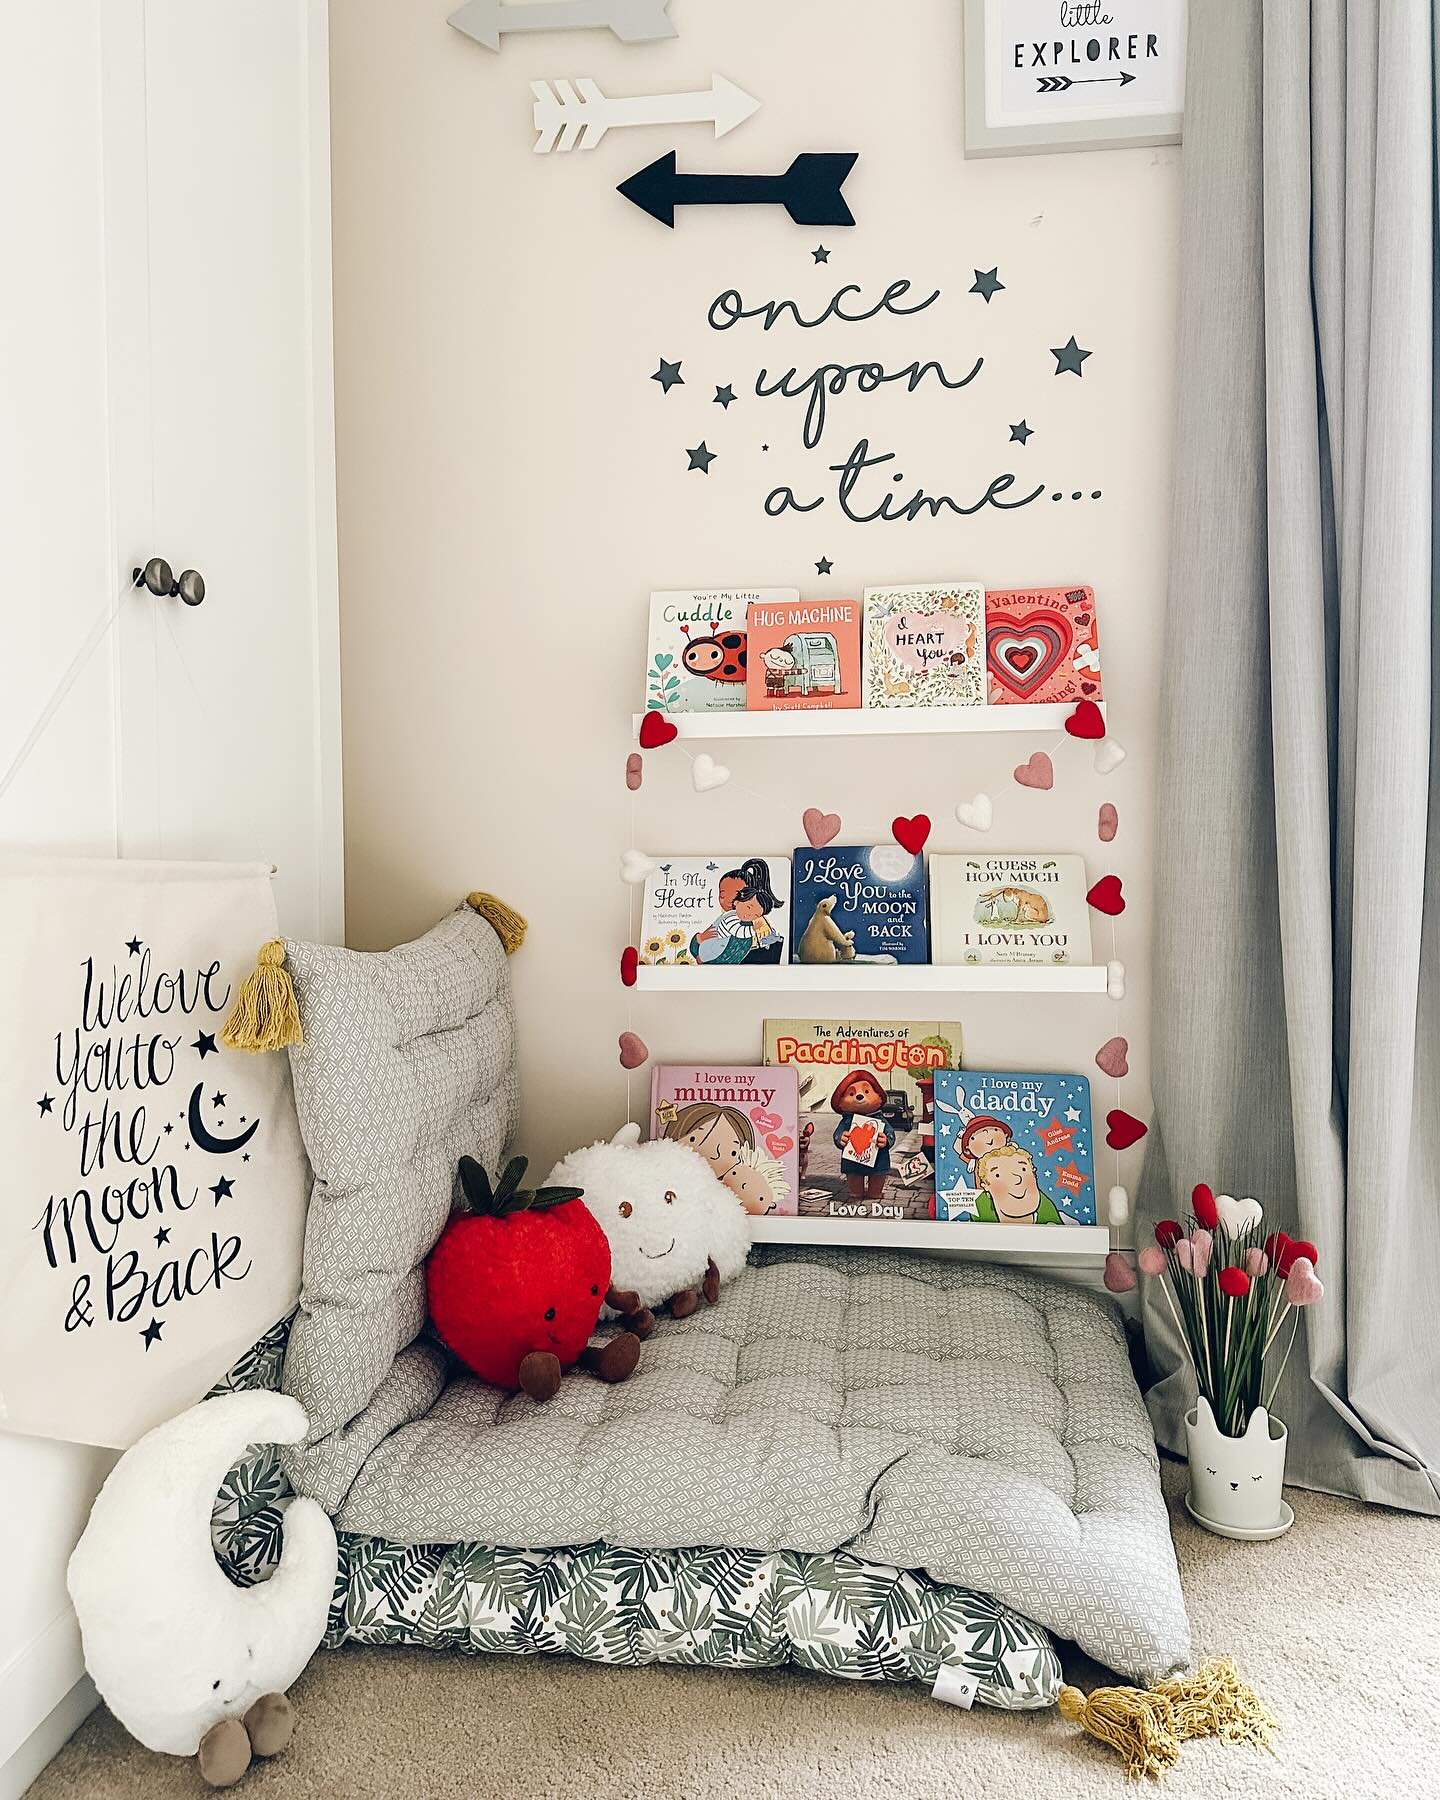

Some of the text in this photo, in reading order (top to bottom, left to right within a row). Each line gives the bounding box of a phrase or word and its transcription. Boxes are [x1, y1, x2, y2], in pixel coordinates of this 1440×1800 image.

[1060, 0, 1114, 28] little
[1014, 33, 1159, 68] EXPLORER
[708, 279, 940, 331] once
[755, 357, 984, 449] upon
[764, 487, 825, 517] a
[721, 592, 732, 601] My
[735, 592, 760, 600] Little
[990, 594, 1069, 613] Valentine
[663, 602, 733, 622] Cuddle
[754, 609, 785, 627] HUG
[788, 606, 853, 625] MACHINE
[896, 632, 945, 646] HEART
[799, 857, 866, 885] I Love
[986, 860, 1037, 871] GUESS
[663, 872, 707, 889] In My
[966, 872, 1060, 883] HOW MUCH
[653, 888, 715, 909] Heart
[889, 891, 897, 899] to
[898, 889, 912, 899] the
[862, 902, 917, 915] MOON
[887, 915, 904, 924] and
[867, 926, 913, 938] BACK
[964, 934, 1069, 947] I LOVE YOU
[813, 1025, 910, 1038] The Adventures of
[777, 1037, 947, 1071] Paddington
[695, 1073, 756, 1087] I love my
[981, 1078, 1044, 1093] I love my
[674, 1086, 777, 1106] mummy
[970, 1090, 1055, 1118] daddy
[78, 1096, 160, 1177] the
[829, 1202, 904, 1220] Love Day
[64, 1231, 253, 1333] & Back
